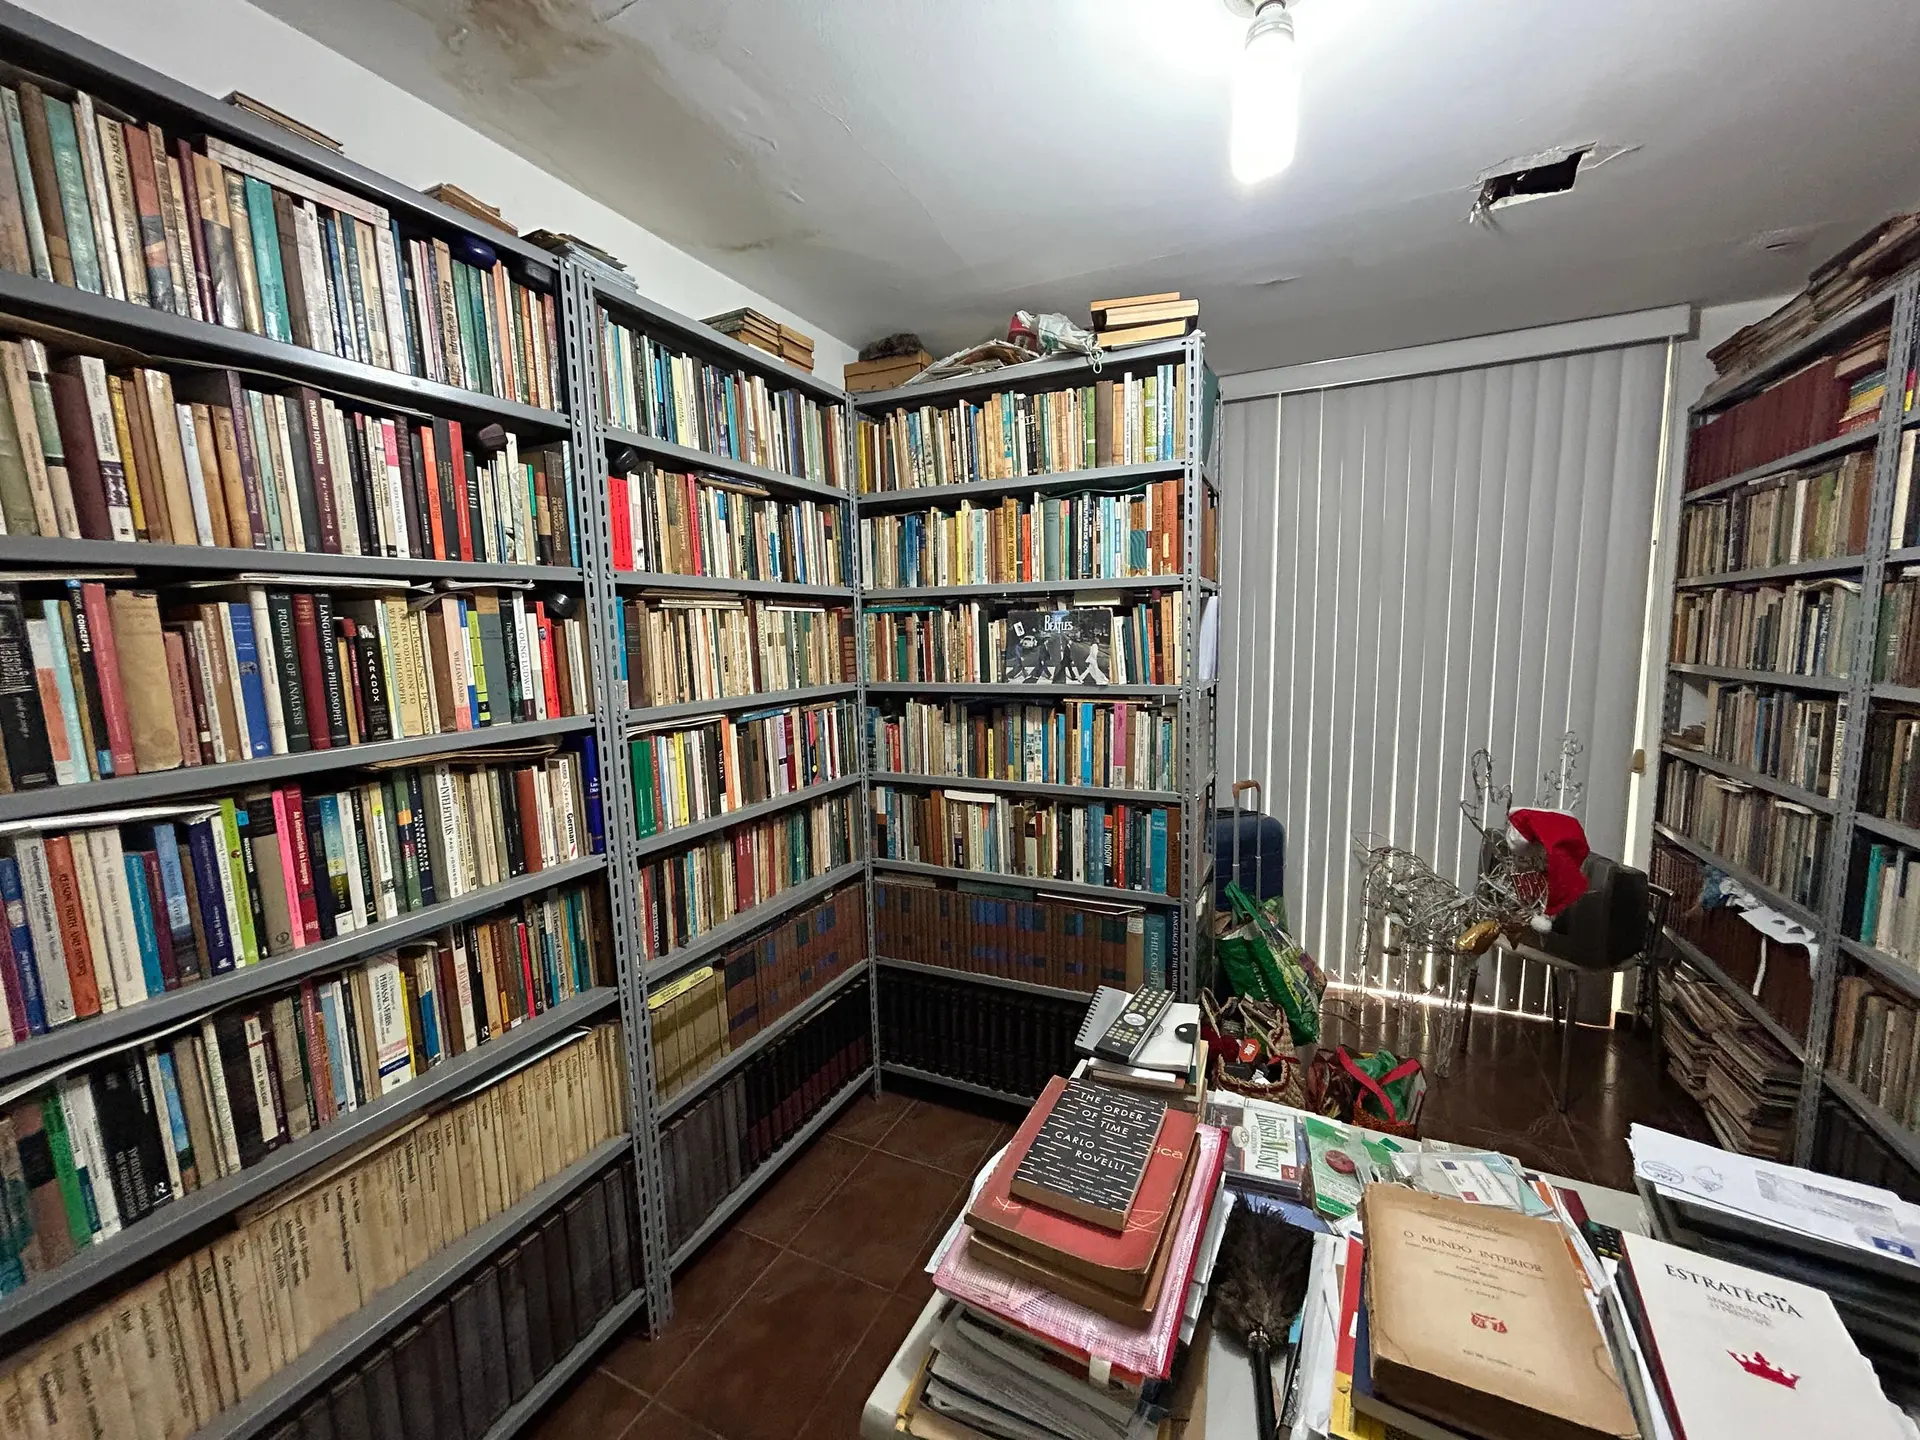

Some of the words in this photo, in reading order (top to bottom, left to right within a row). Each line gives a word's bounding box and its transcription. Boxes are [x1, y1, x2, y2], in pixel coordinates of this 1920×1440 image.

[442, 281, 452, 303] lógica
[443, 314, 458, 355] introdução
[309, 399, 320, 430] EMOCIONAL
[312, 431, 325, 465] INTELIGÊNCIA
[1083, 533, 1088, 541] DE
[76, 614, 90, 653] CONCEPTS
[277, 608, 294, 659] PROBLEMS
[319, 604, 337, 653] LANGUAGE
[1044, 615, 1074, 632] BEATLES
[388, 608, 398, 648] WESTERN
[393, 652, 407, 705] PHILOSOPHY
[412, 623, 420, 636] The
[416, 668, 426, 690] Sense
[506, 632, 516, 661] Philosophy
[517, 627, 527, 659] YOUNG
[285, 663, 296, 676] OF
[326, 655, 335, 670] AND
[367, 651, 380, 702] PARADOX
[400, 622, 413, 690] INTRODUCTION
[409, 693, 417, 705] TO
[453, 651, 462, 680] WILLIAM
[520, 660, 531, 696] LUDWIG
[288, 680, 303, 725] ANALYSIS
[327, 672, 342, 726] PHILOSOPHY
[456, 681, 465, 704] JAMES
[1832, 721, 1845, 779] PHILOSOPHY
[293, 811, 299, 820] An
[566, 813, 576, 844] German
[295, 820, 305, 852] Introduction
[414, 817, 425, 872] MATHEMATICS
[418, 809, 428, 859] PHILOSOPHY
[423, 862, 430, 871] OF
[440, 786, 454, 836] INTELECTUAIS
[450, 856, 458, 887] JOHNSON
[1104, 832, 1112, 867] PHILOSOPHY
[243, 837, 254, 873] WITTGENSTEIN
[356, 829, 364, 843] Uma
[363, 877, 371, 895] Mente
[298, 859, 310, 885] Language
[336, 877, 342, 886] DO
[338, 887, 346, 909] TEMPO
[1172, 947, 1178, 956] OF
[383, 1005, 393, 1027] VERBS
[258, 1080, 269, 1107] REALIDADE
[1080, 1092, 1102, 1104] THE
[1082, 1109, 1098, 1119] OF
[1100, 1120, 1129, 1135] TIME
[1103, 1104, 1143, 1121] ORDER
[1255, 1113, 1287, 1139] IRISH
[1055, 1131, 1095, 1149] CARLO
[1255, 1139, 1288, 1172] MUSIC
[1075, 1150, 1125, 1172] ROVELLI
[1403, 1230, 1414, 1238] O
[1421, 1235, 1471, 1254] MUNDO
[1479, 1250, 1543, 1273] INTERIOR
[1665, 1263, 1805, 1320] ESTRATÉGIA
